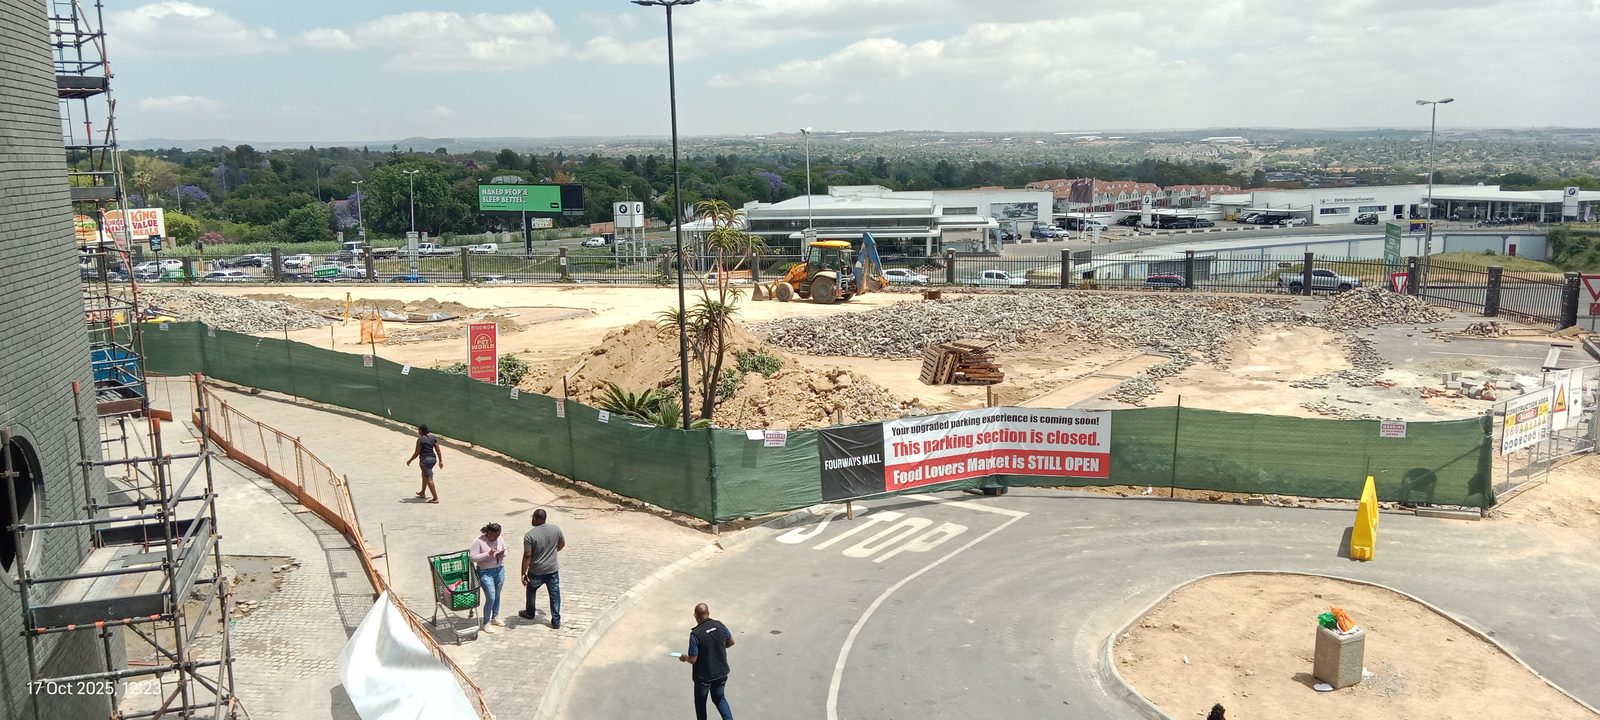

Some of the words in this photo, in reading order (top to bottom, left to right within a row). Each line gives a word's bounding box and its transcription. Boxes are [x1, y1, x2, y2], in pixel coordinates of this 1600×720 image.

[131, 220, 158, 229] VALUE
[132, 227, 159, 236] MEALS
[1507, 400, 1537, 417] CONSTRUCTION
[1538, 397, 1549, 405] AREA
[891, 427, 912, 437] Your
[911, 420, 949, 434] upgraded
[951, 416, 981, 429] parking
[982, 413, 1028, 424] experience
[1030, 414, 1038, 423] is
[1040, 415, 1073, 426] coming
[1075, 417, 1099, 426] soon!
[892, 441, 920, 458] This
[924, 434, 973, 455] parking
[976, 428, 1027, 445] section
[1030, 429, 1043, 444] is
[1046, 430, 1100, 446] closed.
[825, 456, 862, 471] FOURWAYS
[862, 453, 882, 465] MALL
[893, 467, 922, 485] Food
[925, 461, 965, 479] Lovers
[967, 455, 1010, 472] Market
[1012, 454, 1025, 469] is
[1028, 455, 1062, 471] STILL
[1065, 456, 1100, 472] OPEN
[776, 505, 969, 564] STOP
